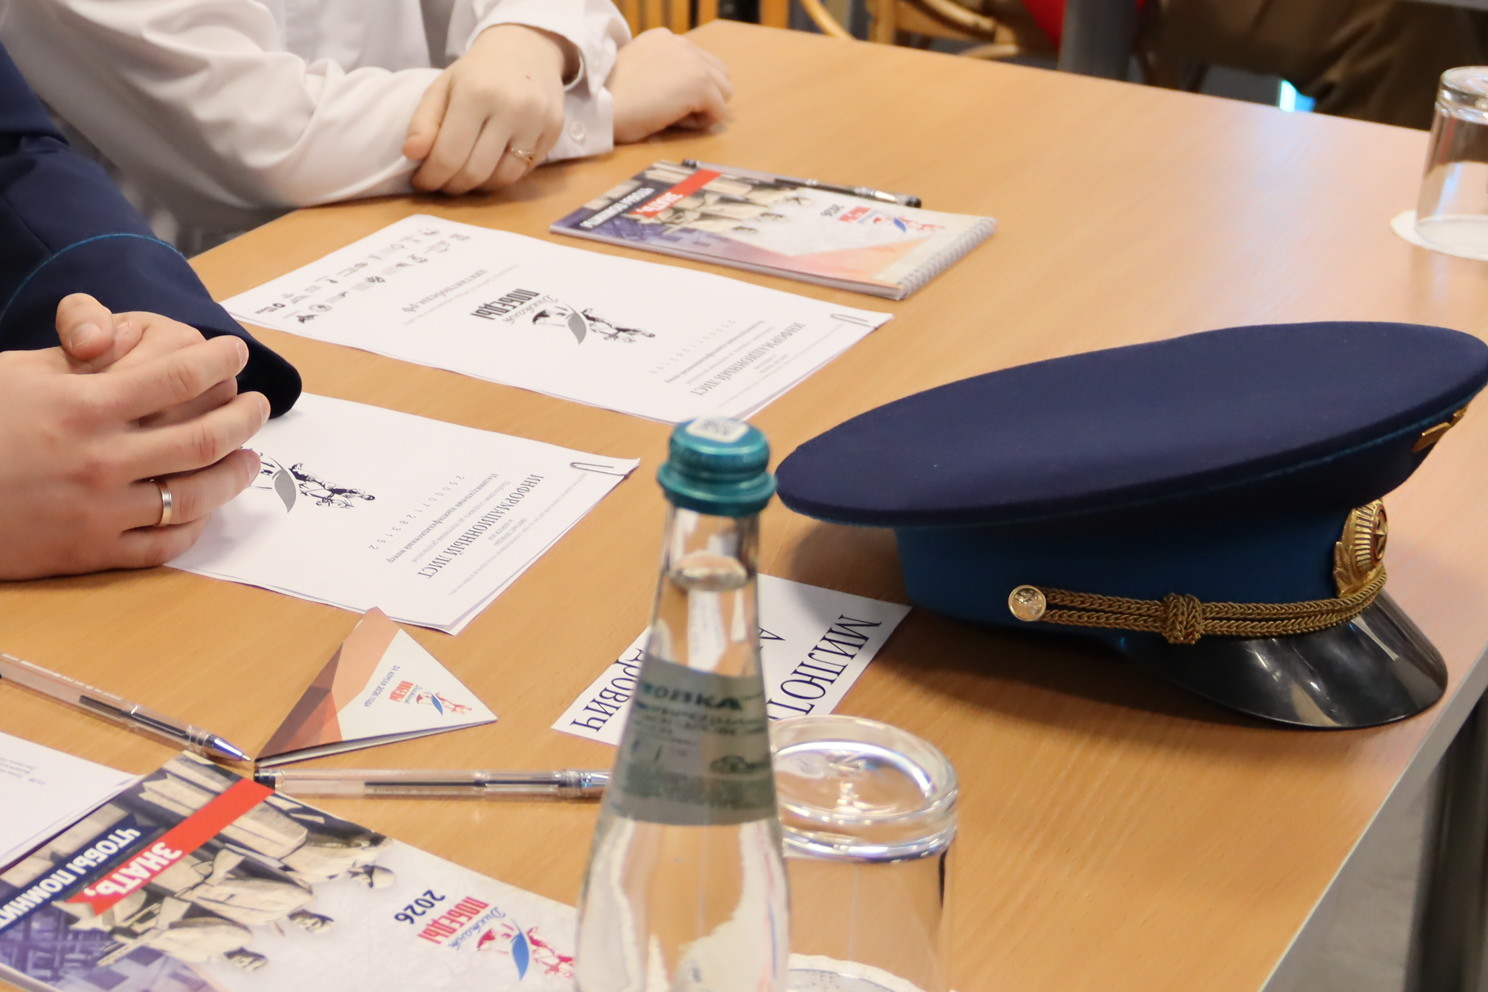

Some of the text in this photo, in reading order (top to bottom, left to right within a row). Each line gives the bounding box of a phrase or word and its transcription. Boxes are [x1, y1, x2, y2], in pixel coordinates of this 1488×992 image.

[471, 289, 540, 320] ПОБЕДЫ
[443, 474, 544, 555] ИНФОРМАЦИОННЫЙ
[418, 555, 452, 578] ЛИСТ
[66, 827, 141, 875] ЧТОБЫ
[83, 842, 183, 897] ЗНАТЬ,
[394, 889, 446, 924] 2026
[417, 896, 489, 945] ПОБЕДЫ
[448, 907, 506, 950] Диктант
